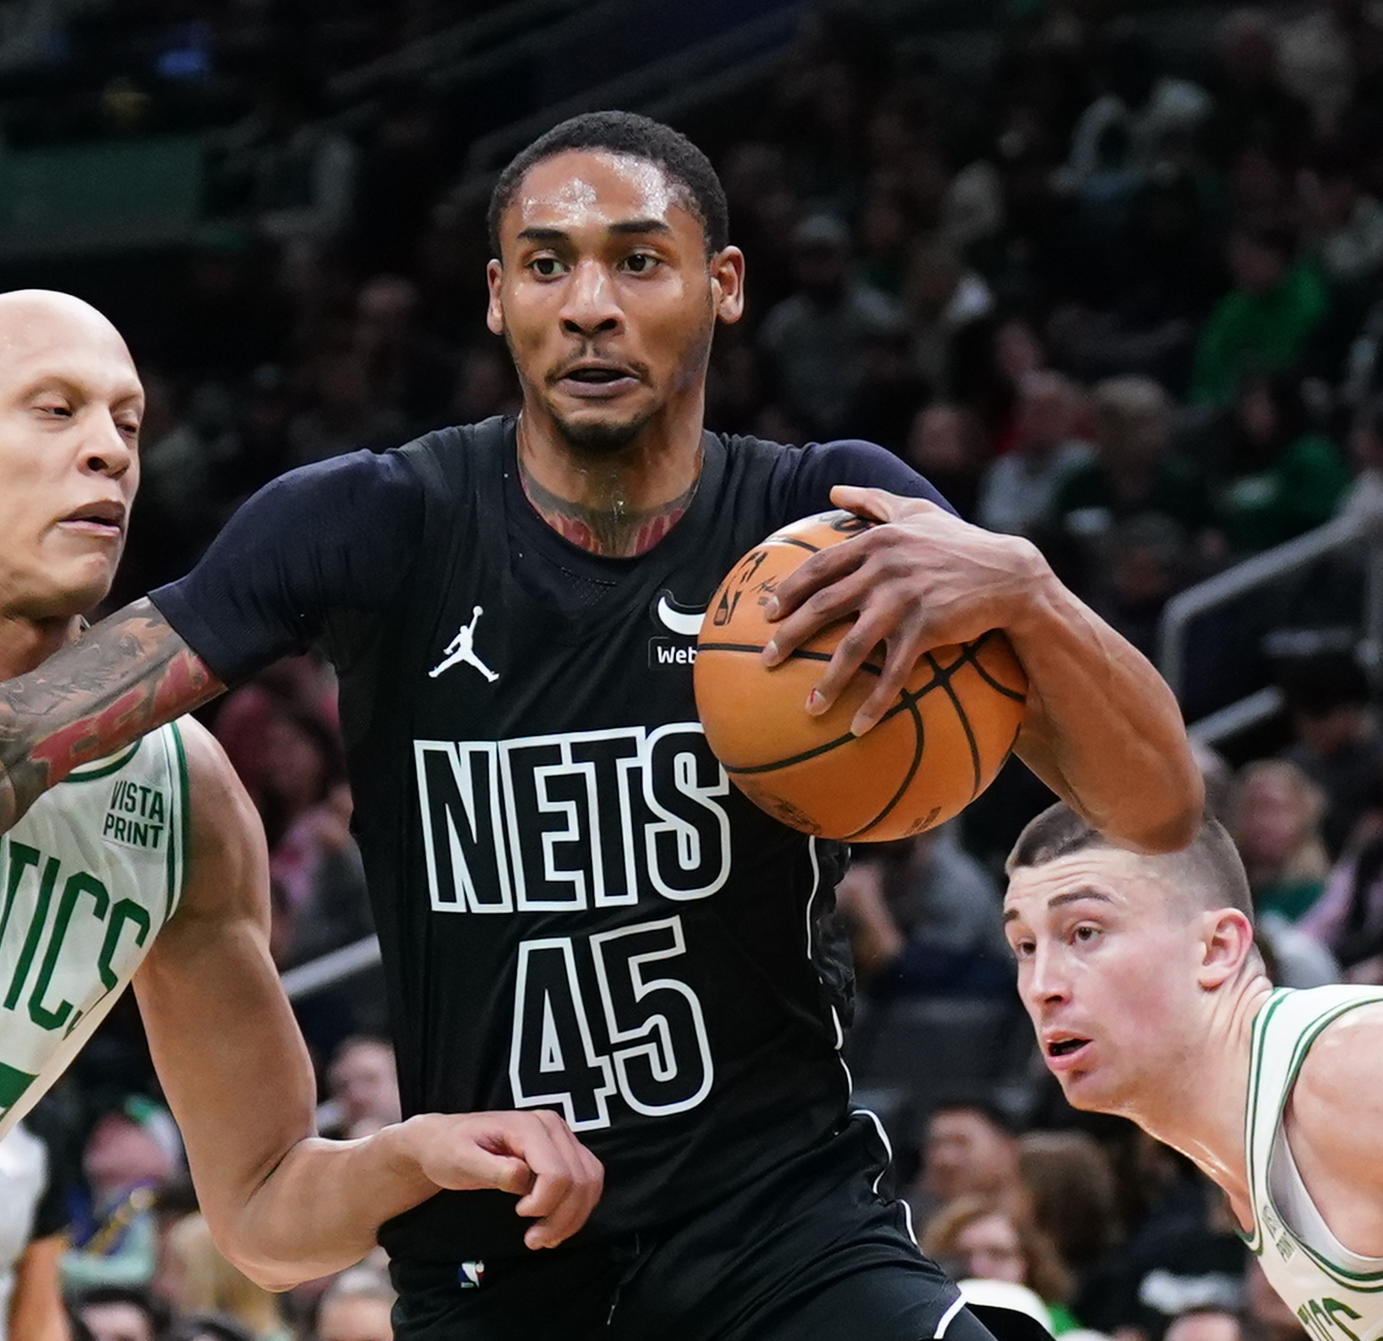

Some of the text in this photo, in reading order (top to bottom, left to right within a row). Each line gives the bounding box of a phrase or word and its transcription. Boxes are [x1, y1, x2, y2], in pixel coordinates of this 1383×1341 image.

[103, 812, 165, 849] PRINT
[110, 780, 165, 824] VISTA
[414, 722, 731, 914] NETS
[509, 915, 714, 1132] 45
